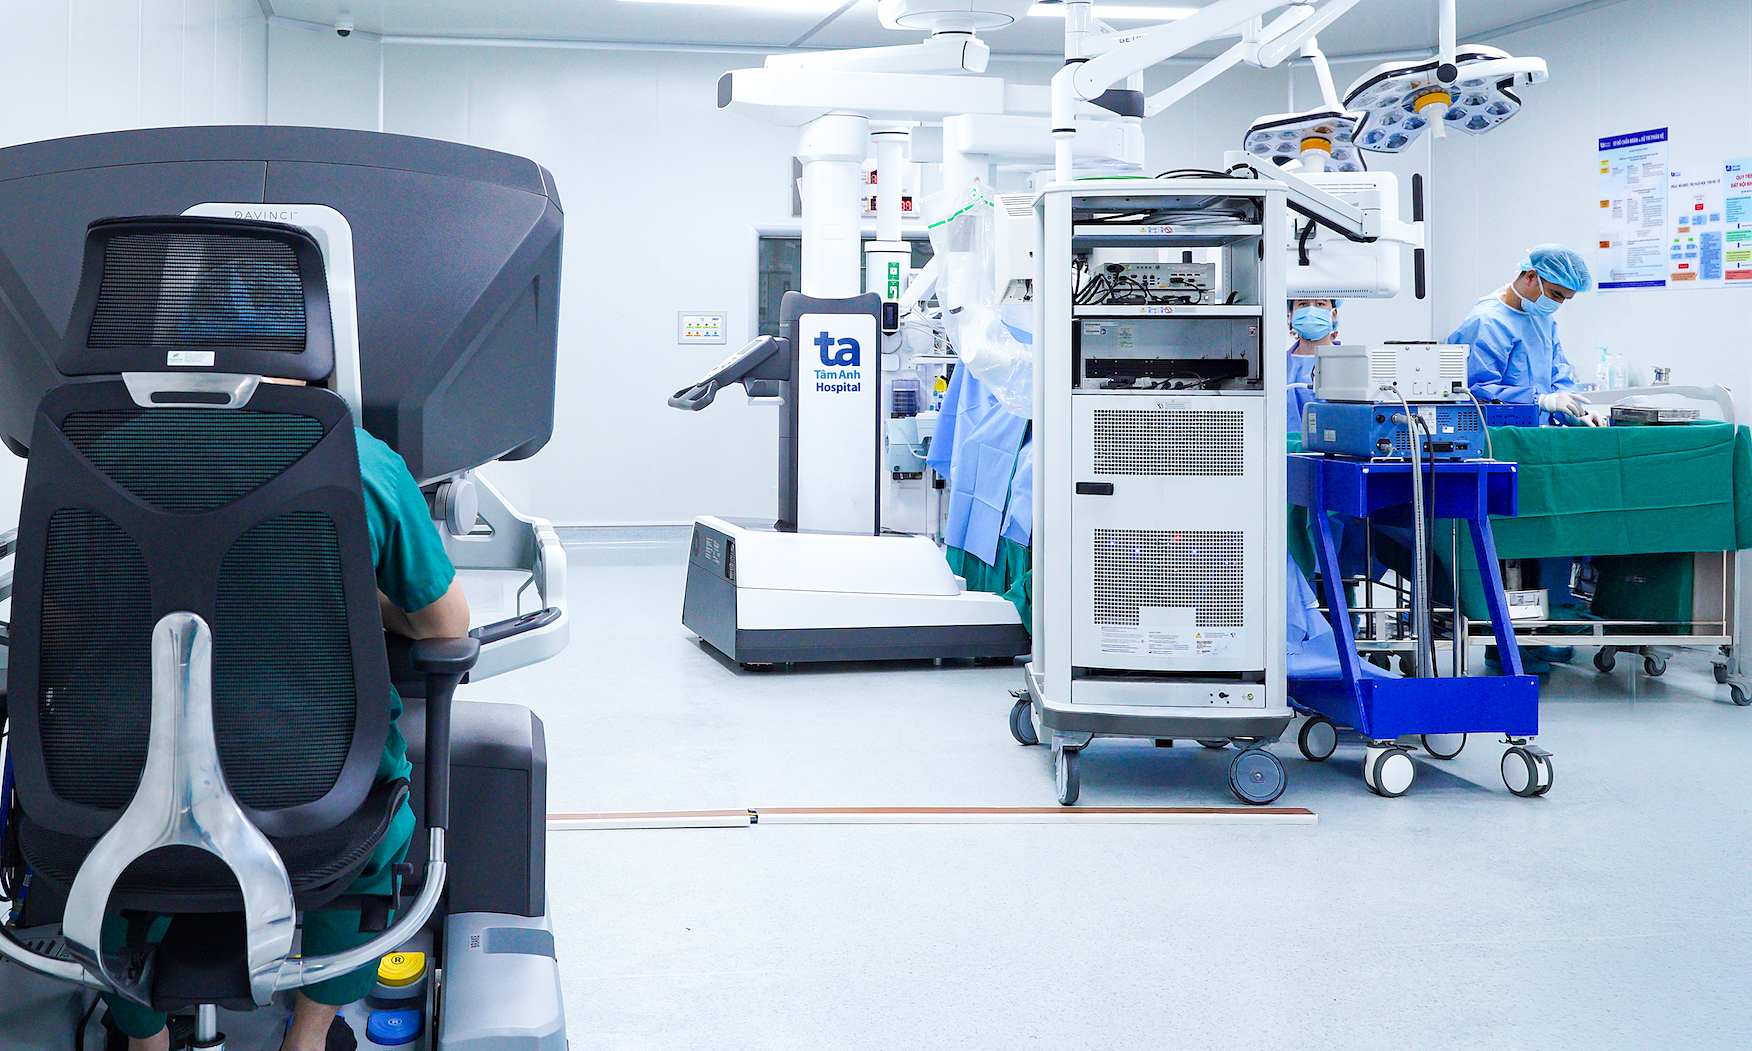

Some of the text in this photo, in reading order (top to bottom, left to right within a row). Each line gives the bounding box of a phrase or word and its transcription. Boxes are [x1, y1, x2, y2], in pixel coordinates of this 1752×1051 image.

[814, 331, 860, 366] ta
[814, 369, 861, 379] Tâm Anh
[816, 382, 861, 394] Hospital
